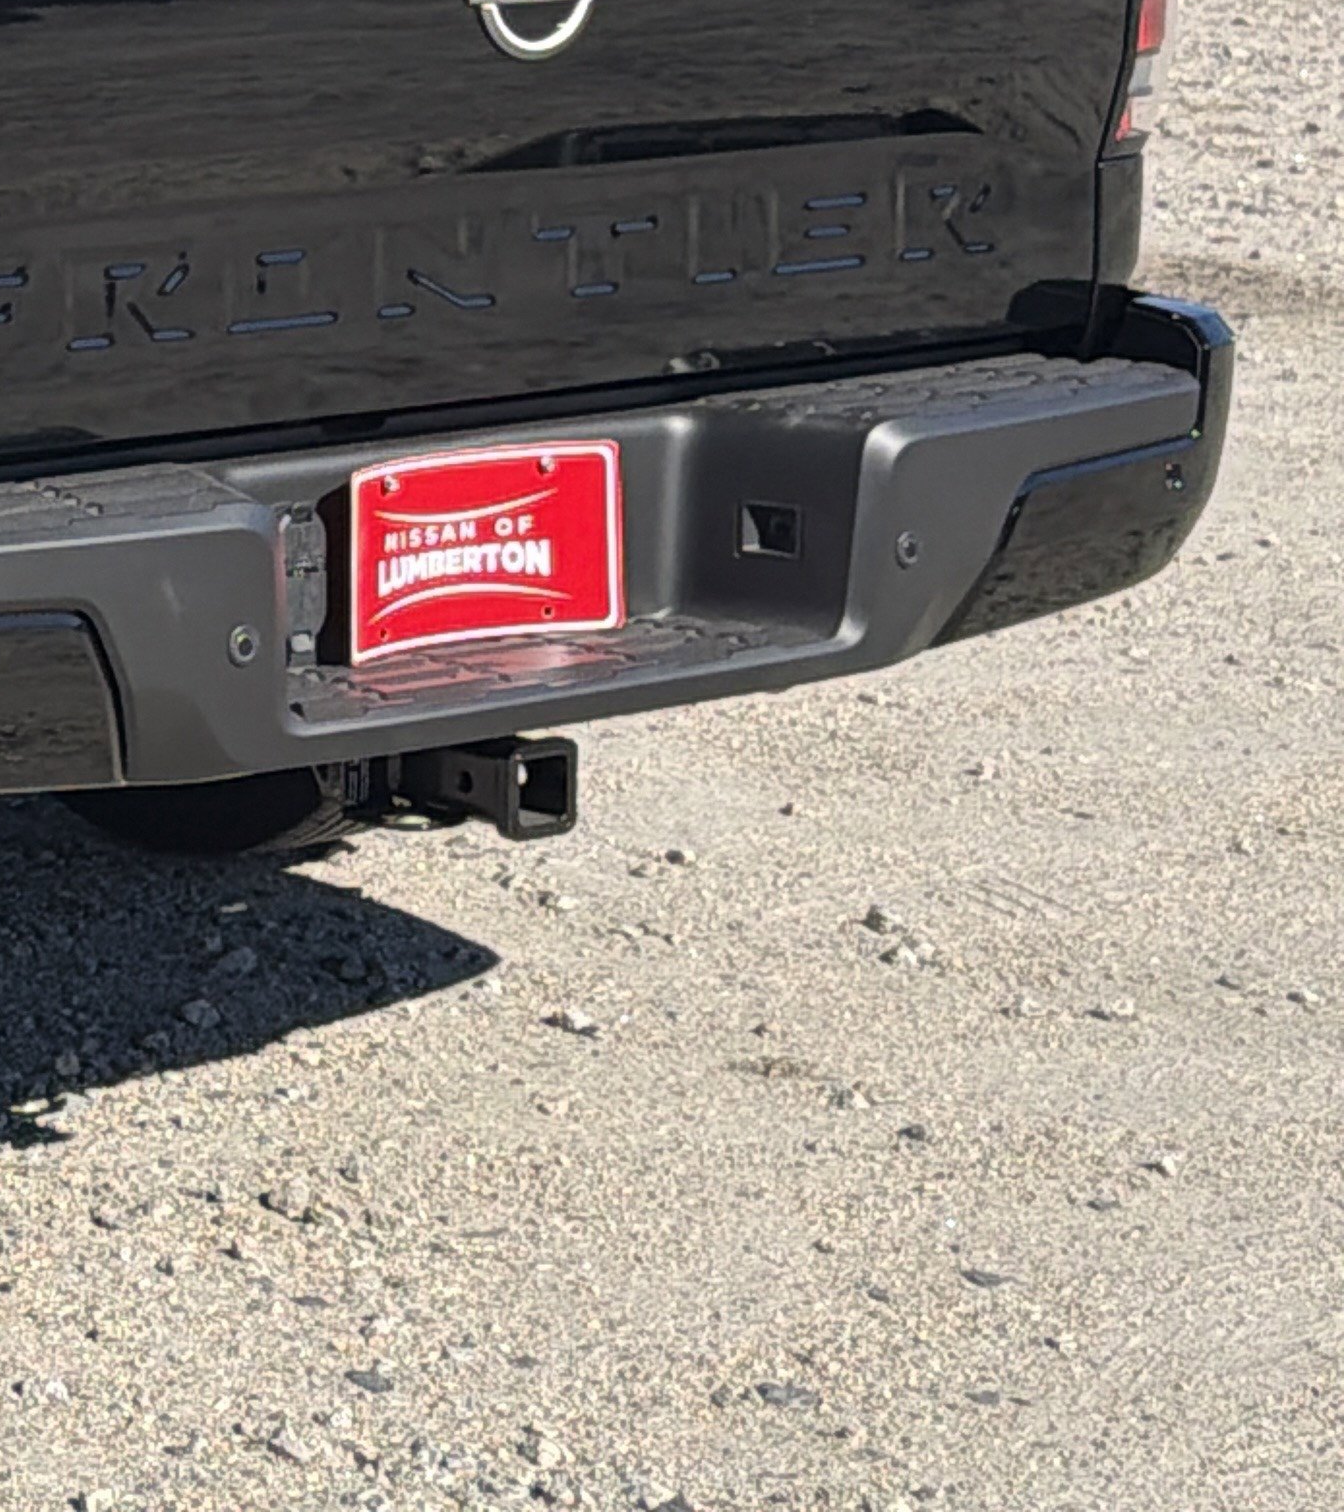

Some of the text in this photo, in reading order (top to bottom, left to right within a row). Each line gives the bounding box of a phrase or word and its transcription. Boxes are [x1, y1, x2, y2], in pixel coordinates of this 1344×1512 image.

[383, 515, 535, 554] NISSAN OF
[378, 539, 552, 597] LUMBERTON
